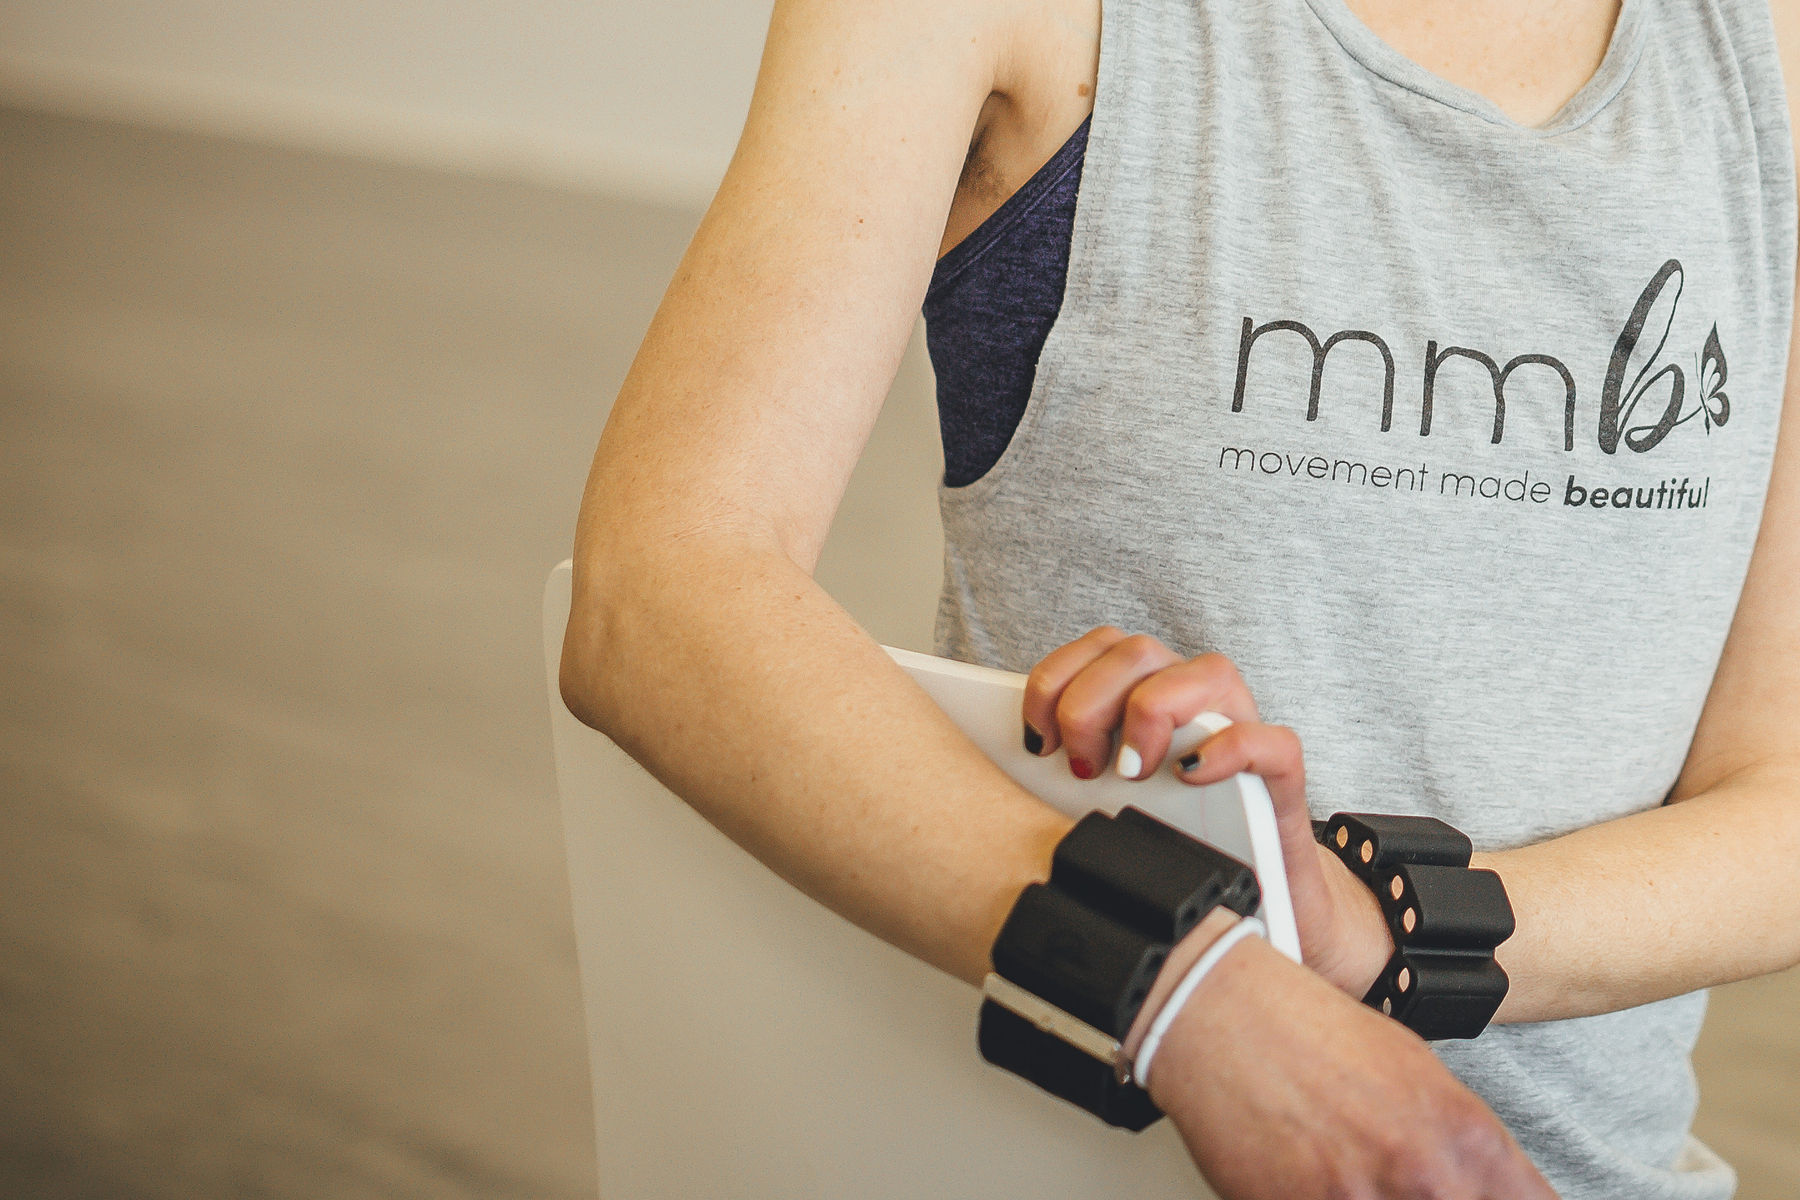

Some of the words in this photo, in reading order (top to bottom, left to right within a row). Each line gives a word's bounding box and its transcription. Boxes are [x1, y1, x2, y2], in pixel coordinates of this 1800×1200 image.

[1231, 258, 1690, 454] mmb
[1218, 446, 1430, 492] movement
[1440, 469, 1552, 504] made
[1563, 474, 1710, 510] beautiful
